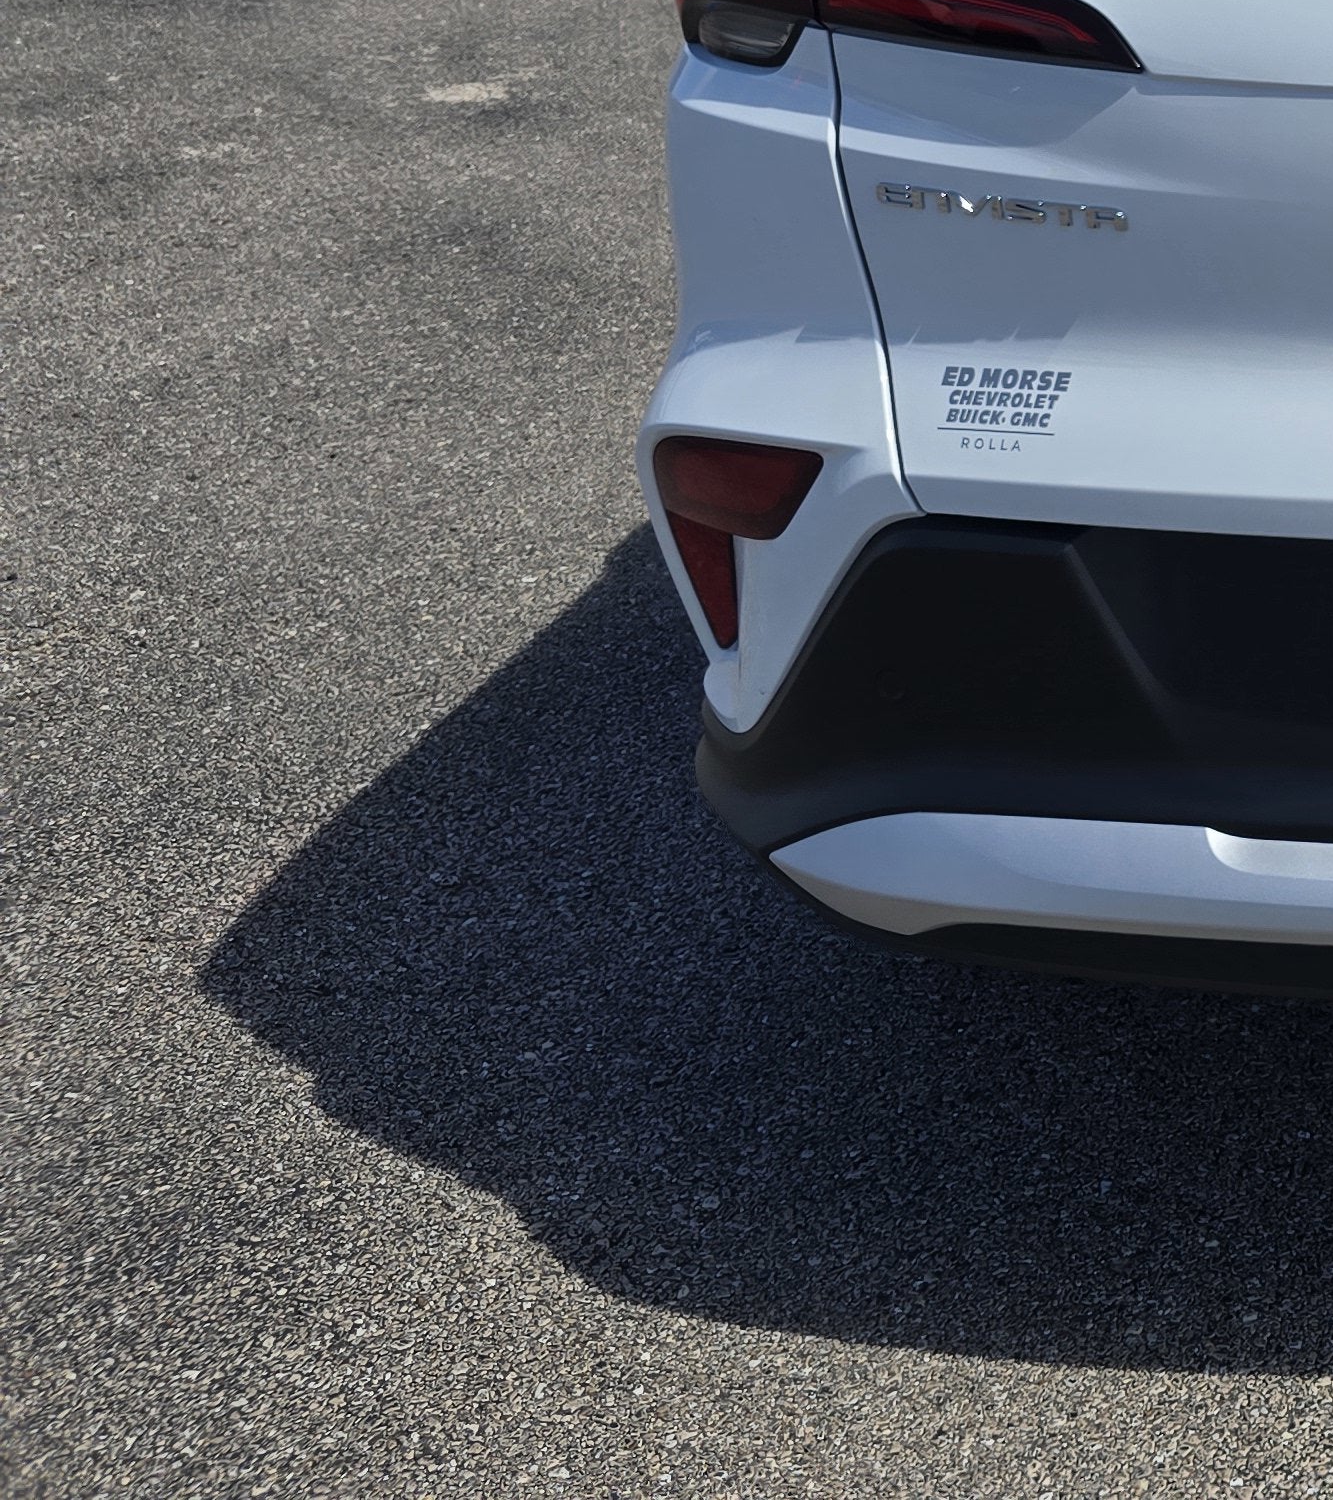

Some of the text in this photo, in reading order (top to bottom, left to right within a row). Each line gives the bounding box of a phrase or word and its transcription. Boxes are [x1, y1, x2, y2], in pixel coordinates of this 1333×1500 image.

[875, 181, 1129, 232] ENVISTA
[941, 365, 1073, 392] ED MORSE
[948, 389, 1061, 410] CHEVROLET
[1009, 411, 1052, 428] GMC
[960, 436, 1022, 452] ROLLA
